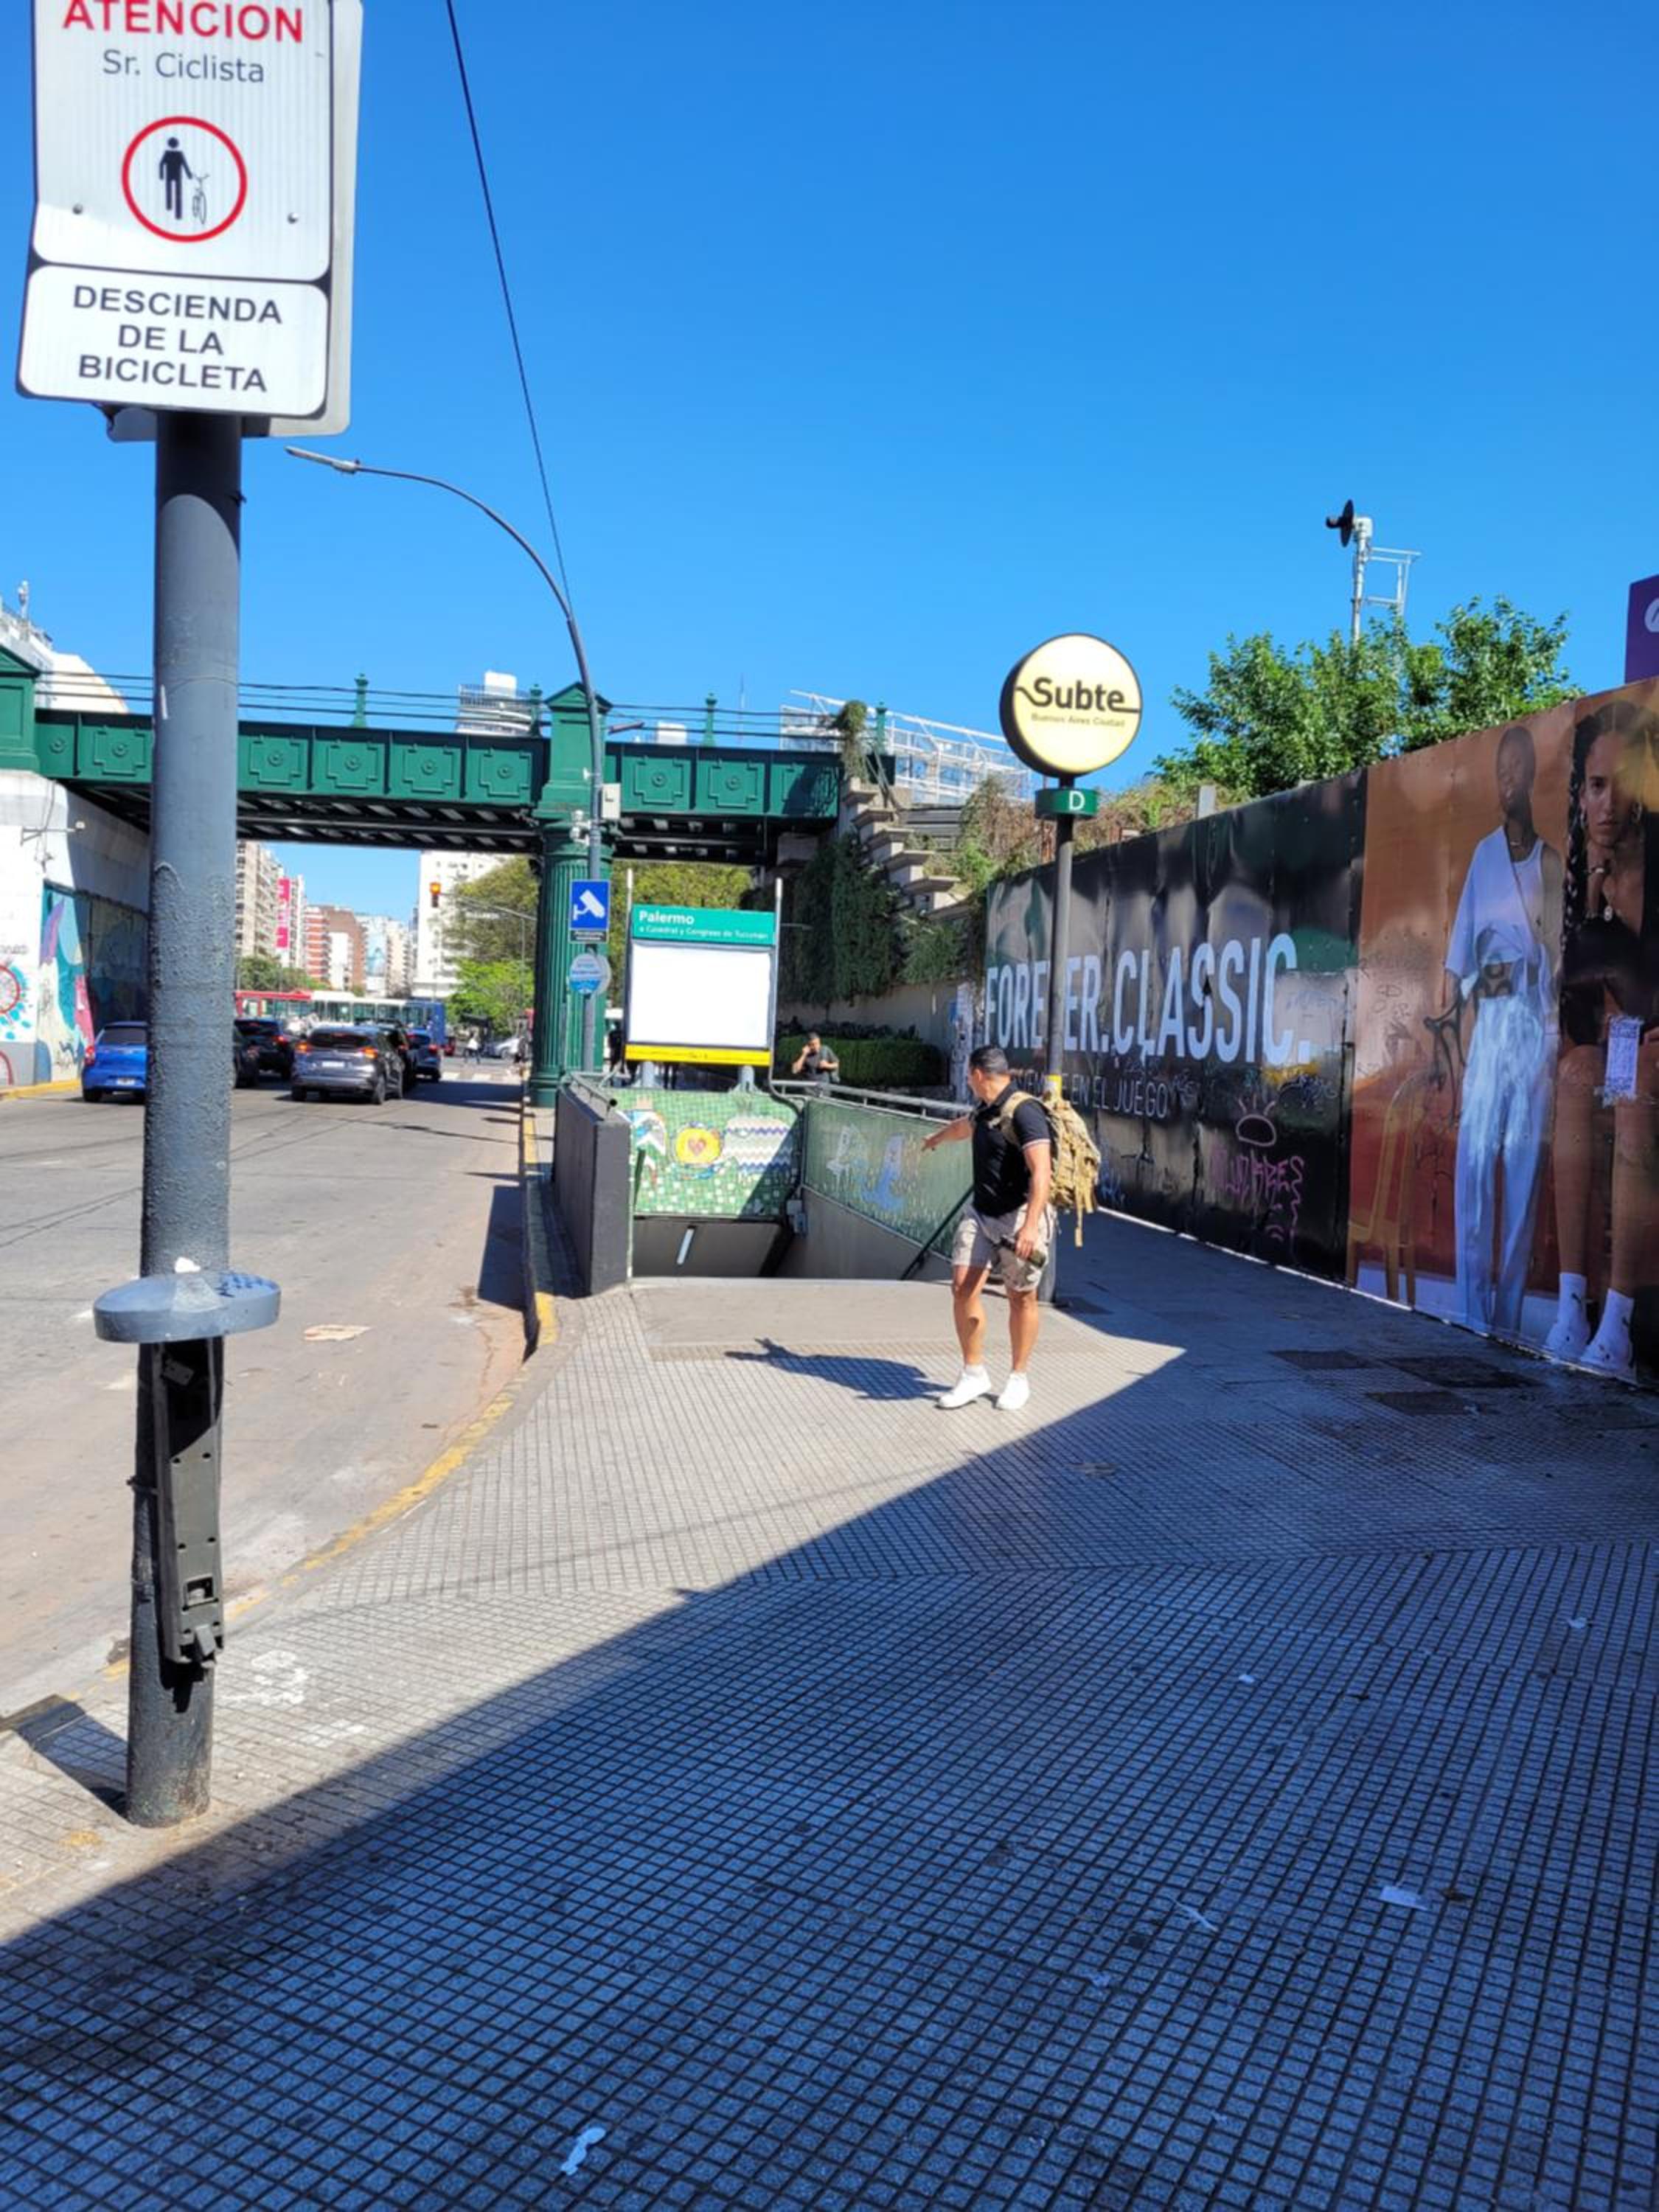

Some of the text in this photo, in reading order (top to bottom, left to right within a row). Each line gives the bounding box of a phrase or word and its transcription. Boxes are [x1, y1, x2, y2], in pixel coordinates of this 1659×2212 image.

[63, 0, 302, 44] ATENCION
[102, 49, 265, 83] Sr. Ciclista
[73, 285, 282, 324] DESCIENDA
[118, 324, 224, 355] DE LA
[78, 354, 268, 393] BICICLETA
[1016, 676, 1140, 713] Subte
[1068, 714, 1091, 726] Aires
[1093, 716, 1126, 727] Ciudad
[1069, 790, 1086, 811] D
[639, 910, 695, 925] Palermo
